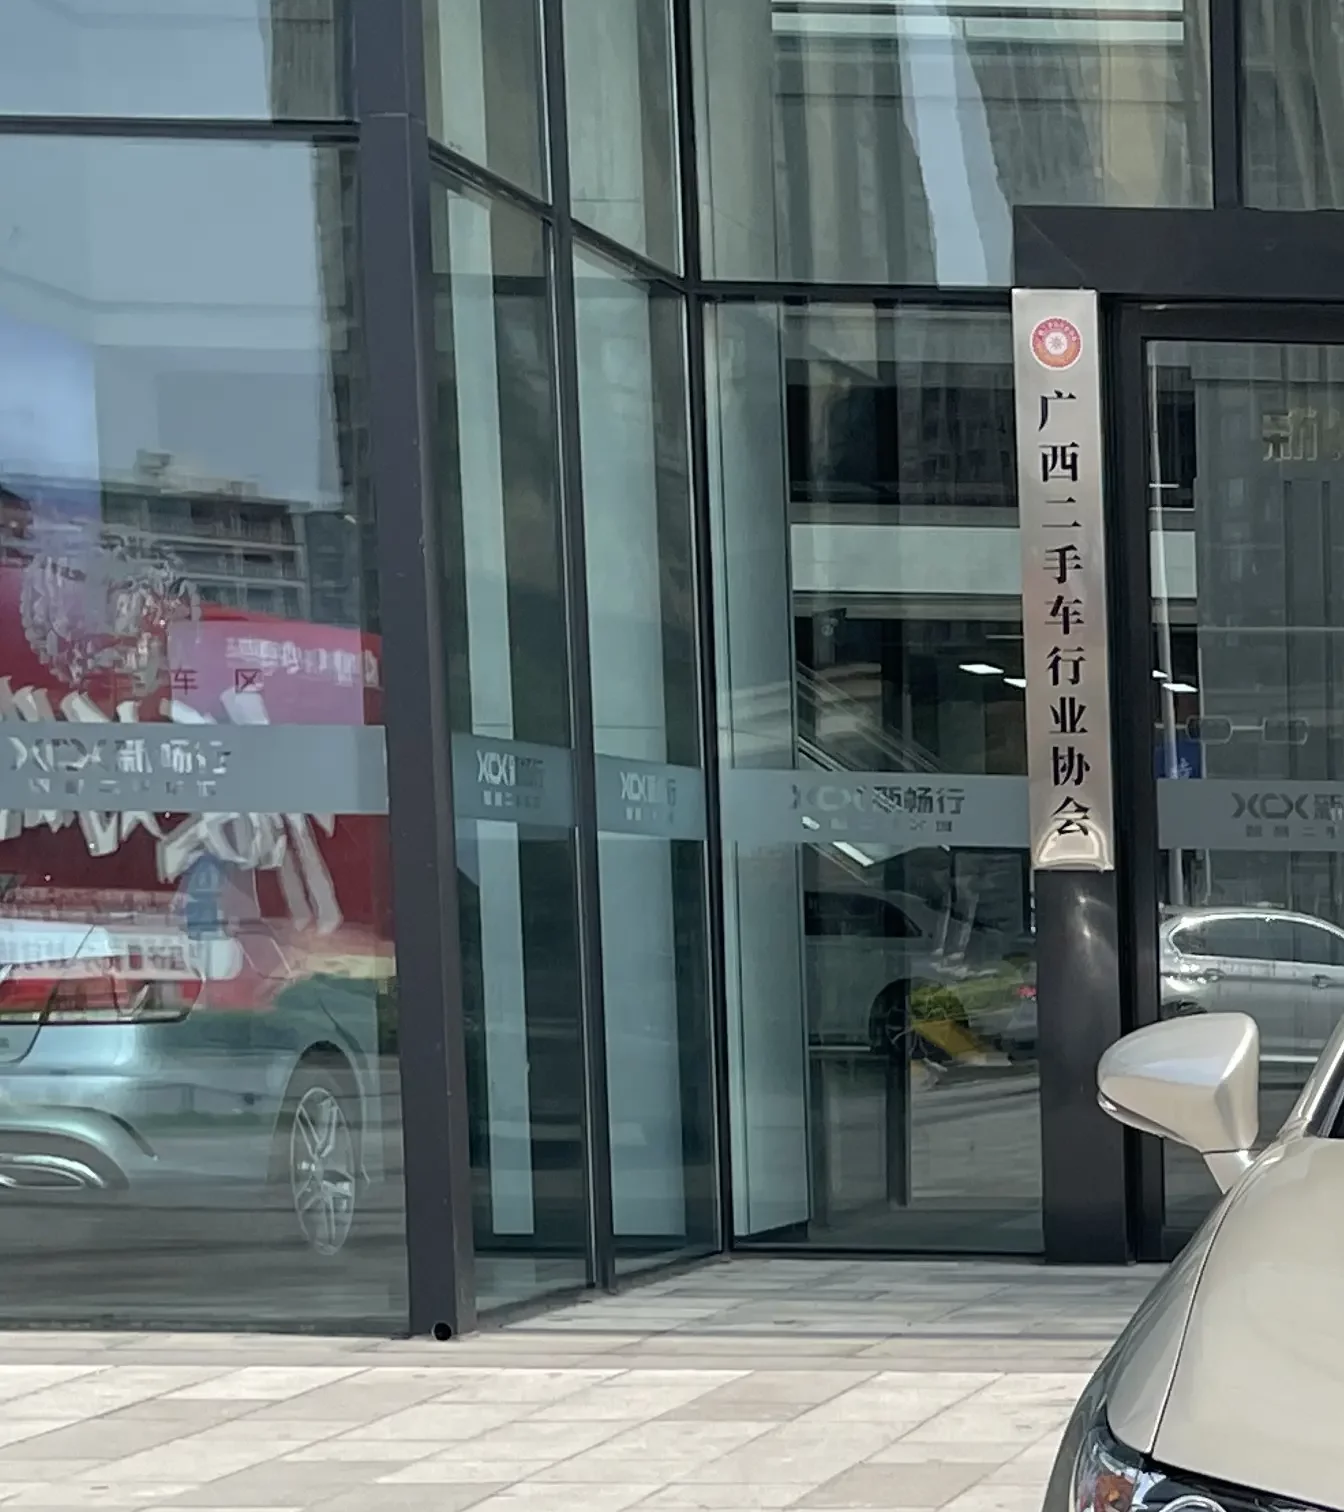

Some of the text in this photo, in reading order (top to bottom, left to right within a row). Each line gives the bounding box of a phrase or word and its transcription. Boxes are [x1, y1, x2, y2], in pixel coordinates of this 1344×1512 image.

[1038, 389, 1090, 837] 广西二手车行业协会
